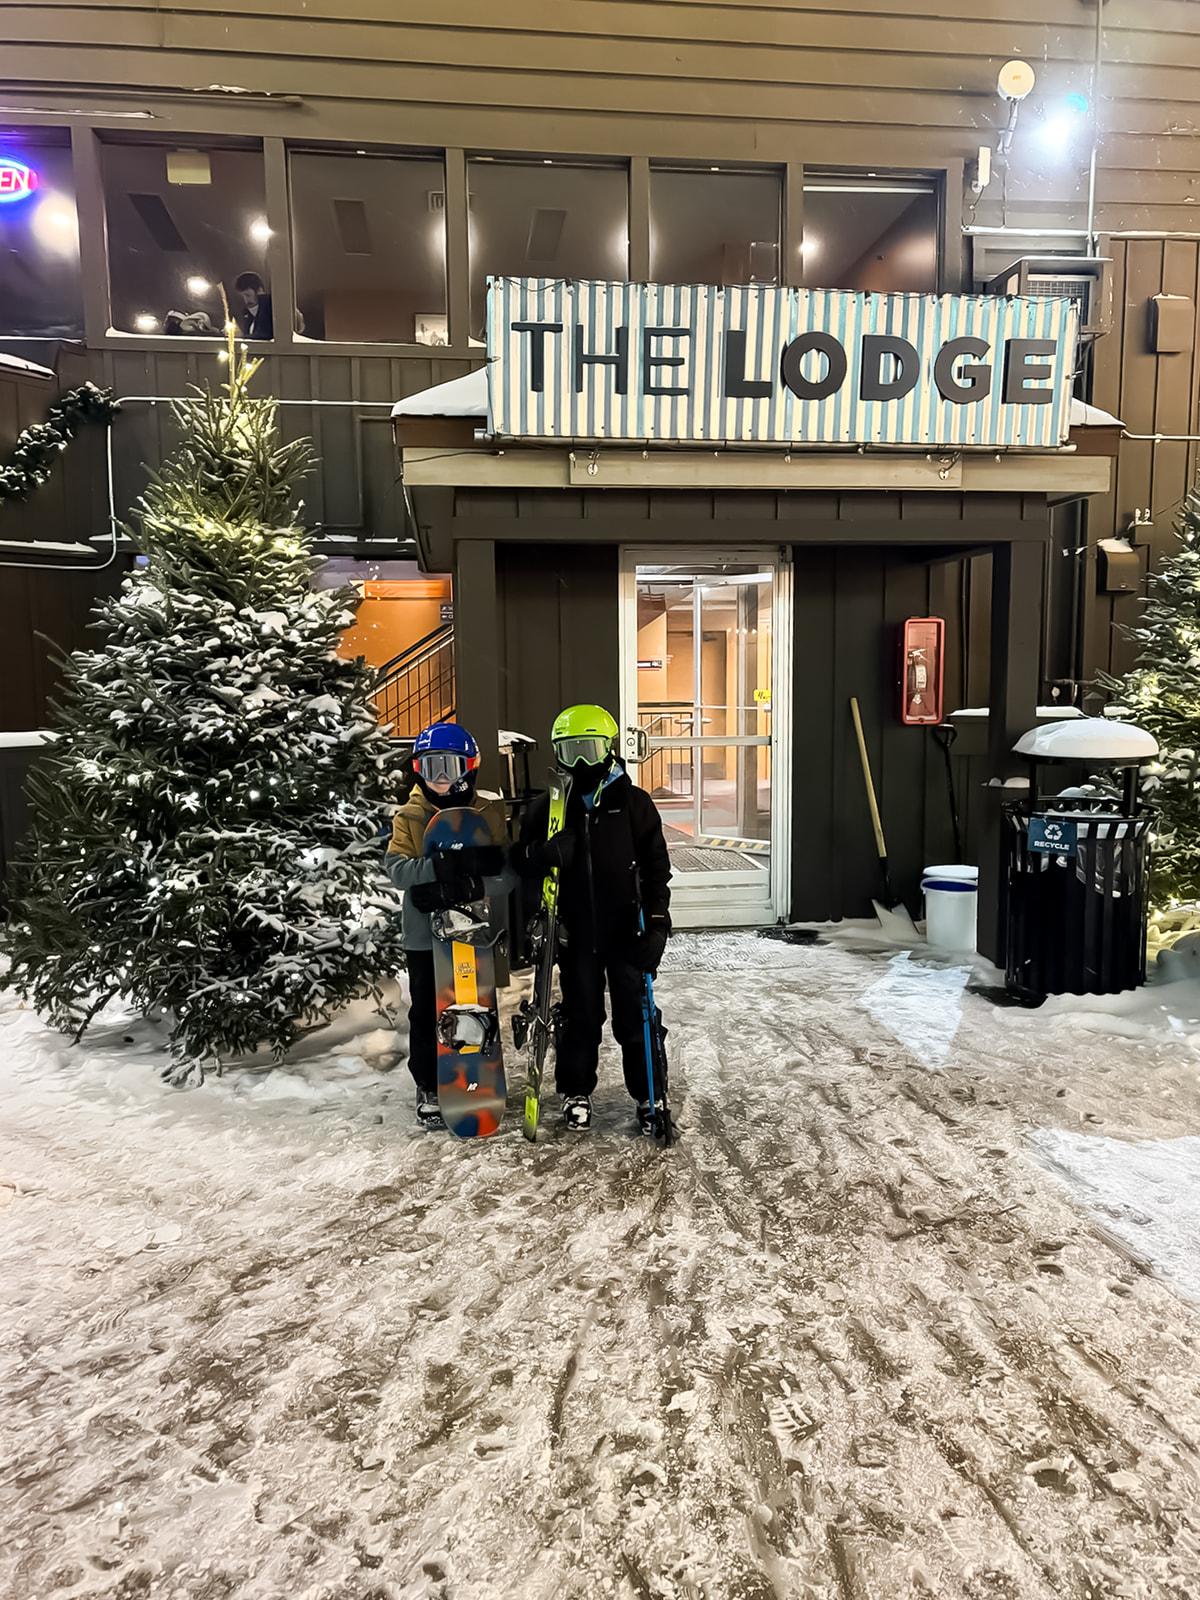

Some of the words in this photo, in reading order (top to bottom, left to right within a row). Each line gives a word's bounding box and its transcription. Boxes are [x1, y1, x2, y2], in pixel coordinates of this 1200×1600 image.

[511, 321, 691, 397] THE
[723, 330, 1057, 406] LODGE
[1034, 840, 1070, 850] RECYCLE
